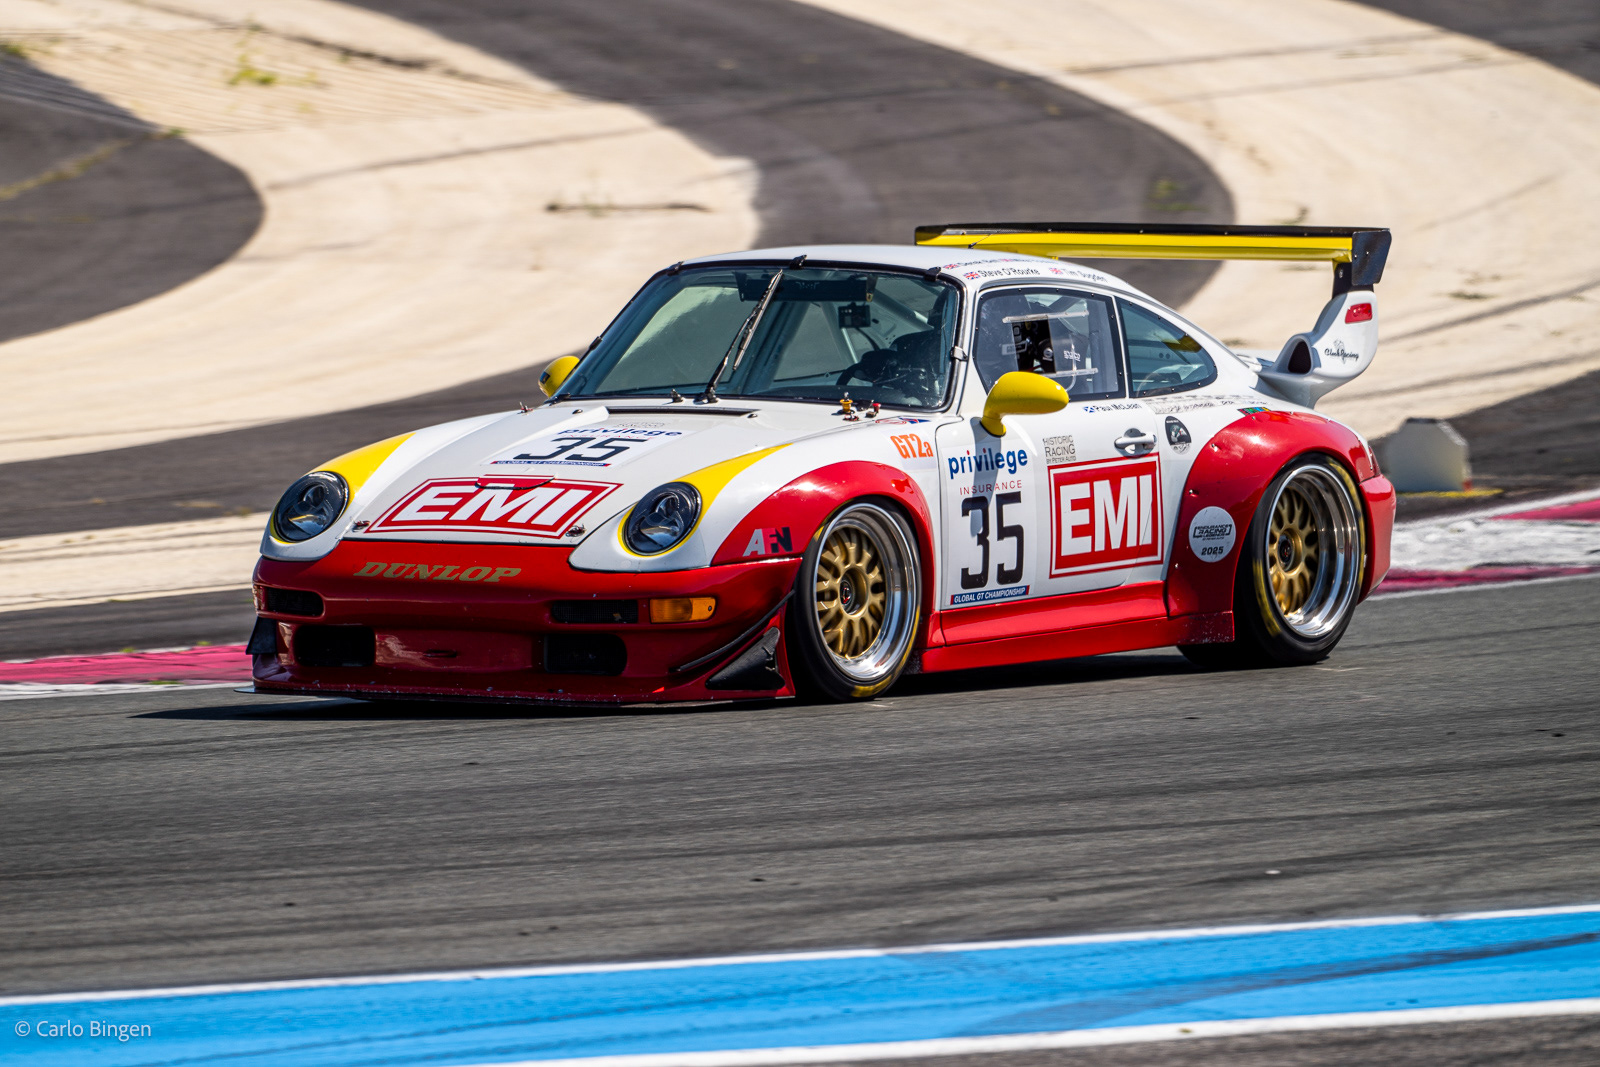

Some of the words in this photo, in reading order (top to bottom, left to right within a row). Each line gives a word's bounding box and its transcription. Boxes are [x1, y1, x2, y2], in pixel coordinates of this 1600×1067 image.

[978, 269, 1003, 277] Steve
[557, 428, 682, 436] privilege
[1042, 435, 1074, 446] HISTORIC
[513, 437, 648, 461] 35
[890, 433, 934, 459] GT2a
[1045, 443, 1076, 457] RACING
[948, 448, 1028, 479] privilege
[960, 480, 1022, 495] INSURANCE
[391, 483, 593, 526] EMI
[1060, 474, 1153, 556] EMI
[742, 526, 793, 557] AFN
[961, 491, 1024, 590] 35
[1201, 546, 1224, 556] 2025
[353, 561, 522, 583] DUNLOP
[954, 594, 976, 603] GLOBAL
[976, 592, 985, 601] GT
[985, 587, 1026, 599] CHAMPIONSHIP
